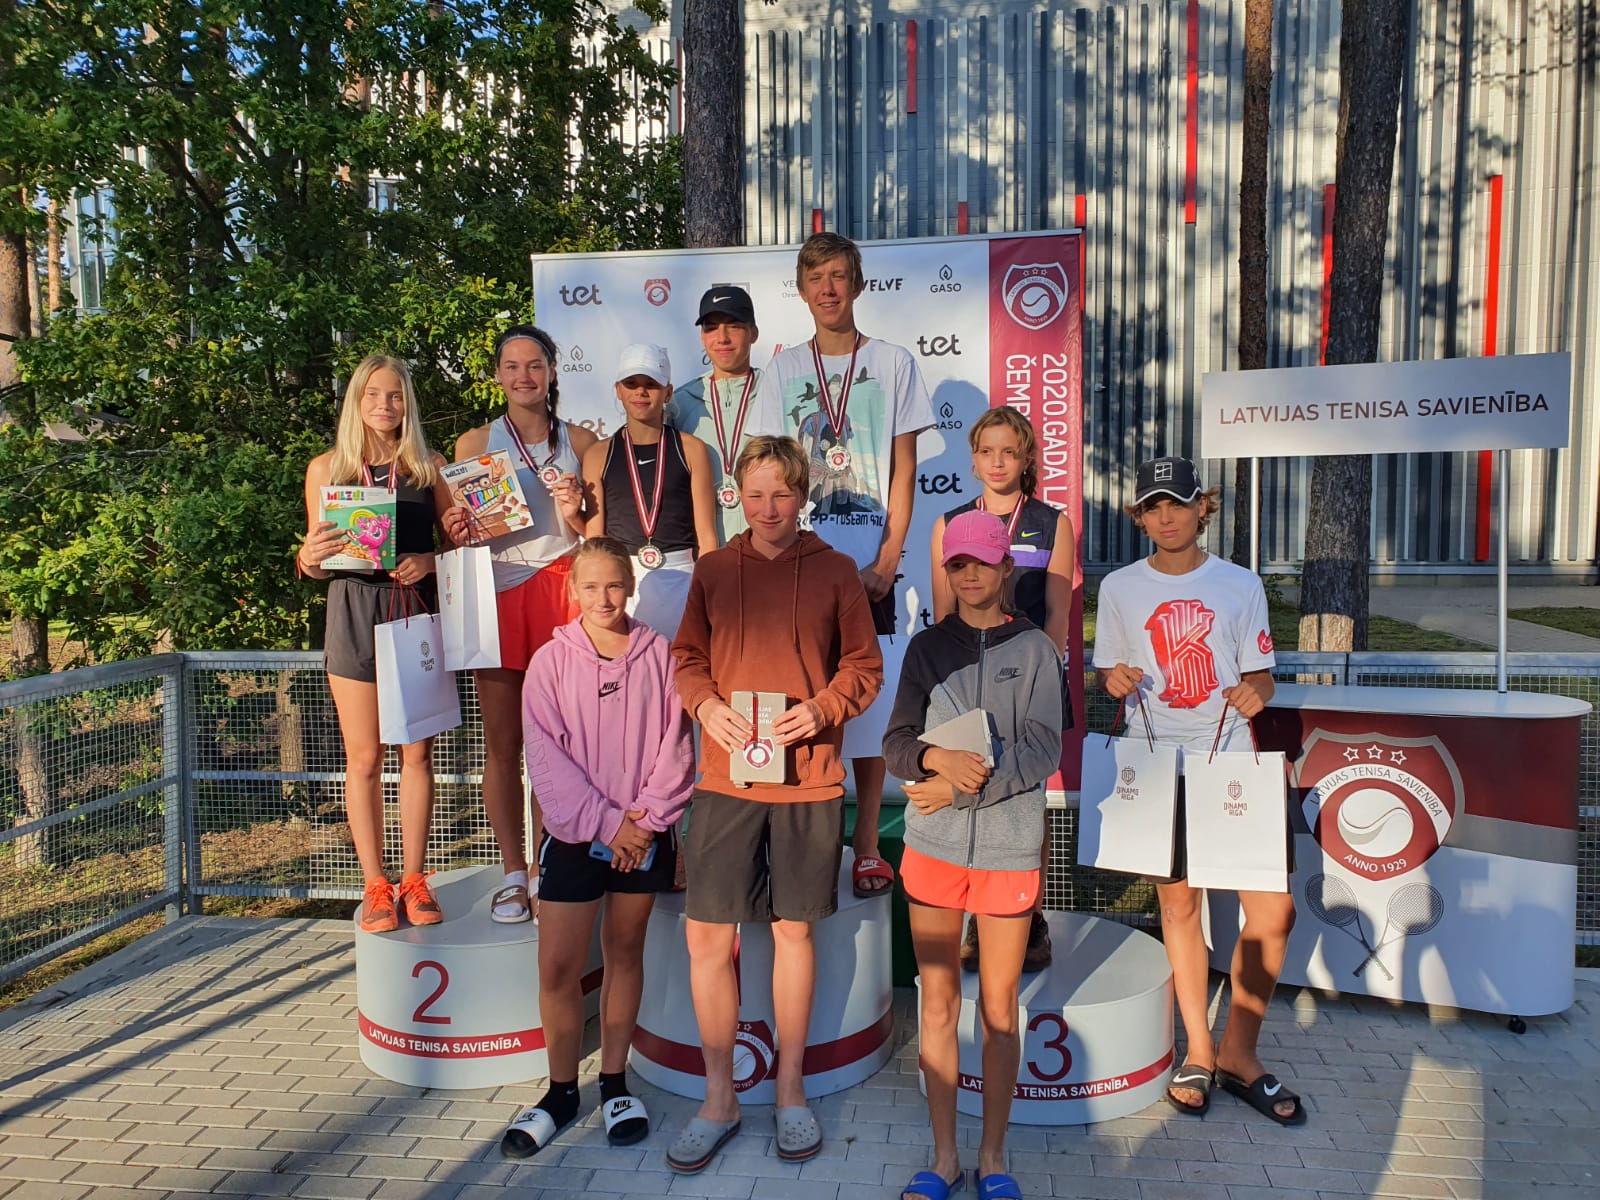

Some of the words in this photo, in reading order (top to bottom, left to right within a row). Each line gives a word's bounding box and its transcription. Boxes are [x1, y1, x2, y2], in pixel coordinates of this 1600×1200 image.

[559, 284, 602, 306] tet
[930, 283, 962, 293] GASO
[916, 334, 961, 356] tet
[563, 364, 593, 373] GASO
[1006, 354, 1037, 421] ČEMP
[1042, 353, 1068, 481] 2020.GADA
[1219, 404, 1320, 425] LATVIJAS
[1326, 400, 1409, 420] TENISA
[1416, 391, 1549, 417] SAVIENĪBA
[918, 472, 963, 495] tet
[1351, 766, 1391, 778] TENISA
[1396, 773, 1443, 817] SAVIENĪBA
[1223, 802, 1248, 811] DINAMO
[1344, 853, 1378, 873] ANNO
[1381, 858, 1408, 873] 1929
[411, 960, 451, 1025] 2
[368, 1025, 406, 1049] LATVIJAS
[408, 1039, 450, 1054] TENISA
[452, 1037, 522, 1054] SAVIENĪBA
[1027, 1012, 1073, 1082] 3
[1021, 1086, 1068, 1098] TENISA
[1070, 1077, 1129, 1097] SAVIENĪBA
[613, 1099, 632, 1111] NIKE
